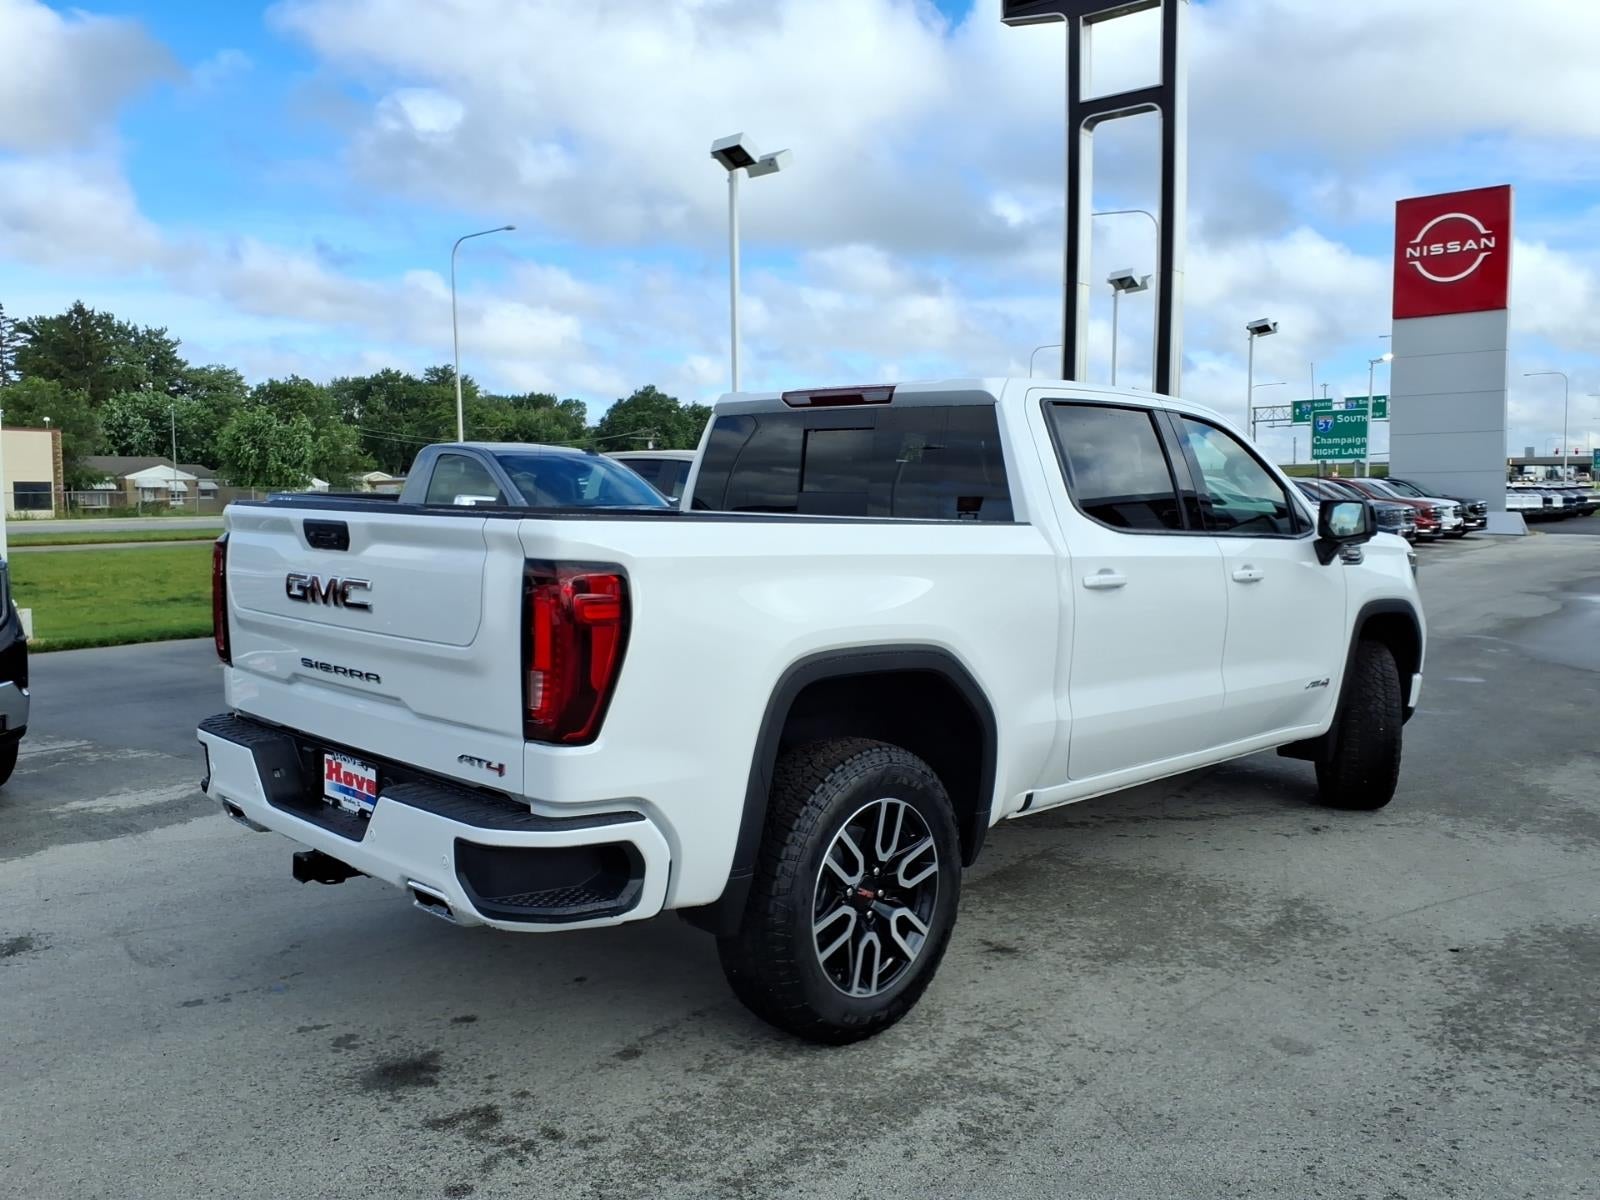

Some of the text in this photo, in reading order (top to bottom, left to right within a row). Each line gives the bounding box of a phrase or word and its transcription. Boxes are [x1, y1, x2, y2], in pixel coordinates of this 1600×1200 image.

[1406, 237, 1496, 258] NISSAN
[1318, 419, 1333, 430] 57
[1313, 436, 1367, 445] Champaign
[1313, 447, 1366, 456] RIGHT LANE
[286, 572, 373, 613] GMC
[301, 657, 382, 684] SIERRA
[457, 754, 505, 778] AT4
